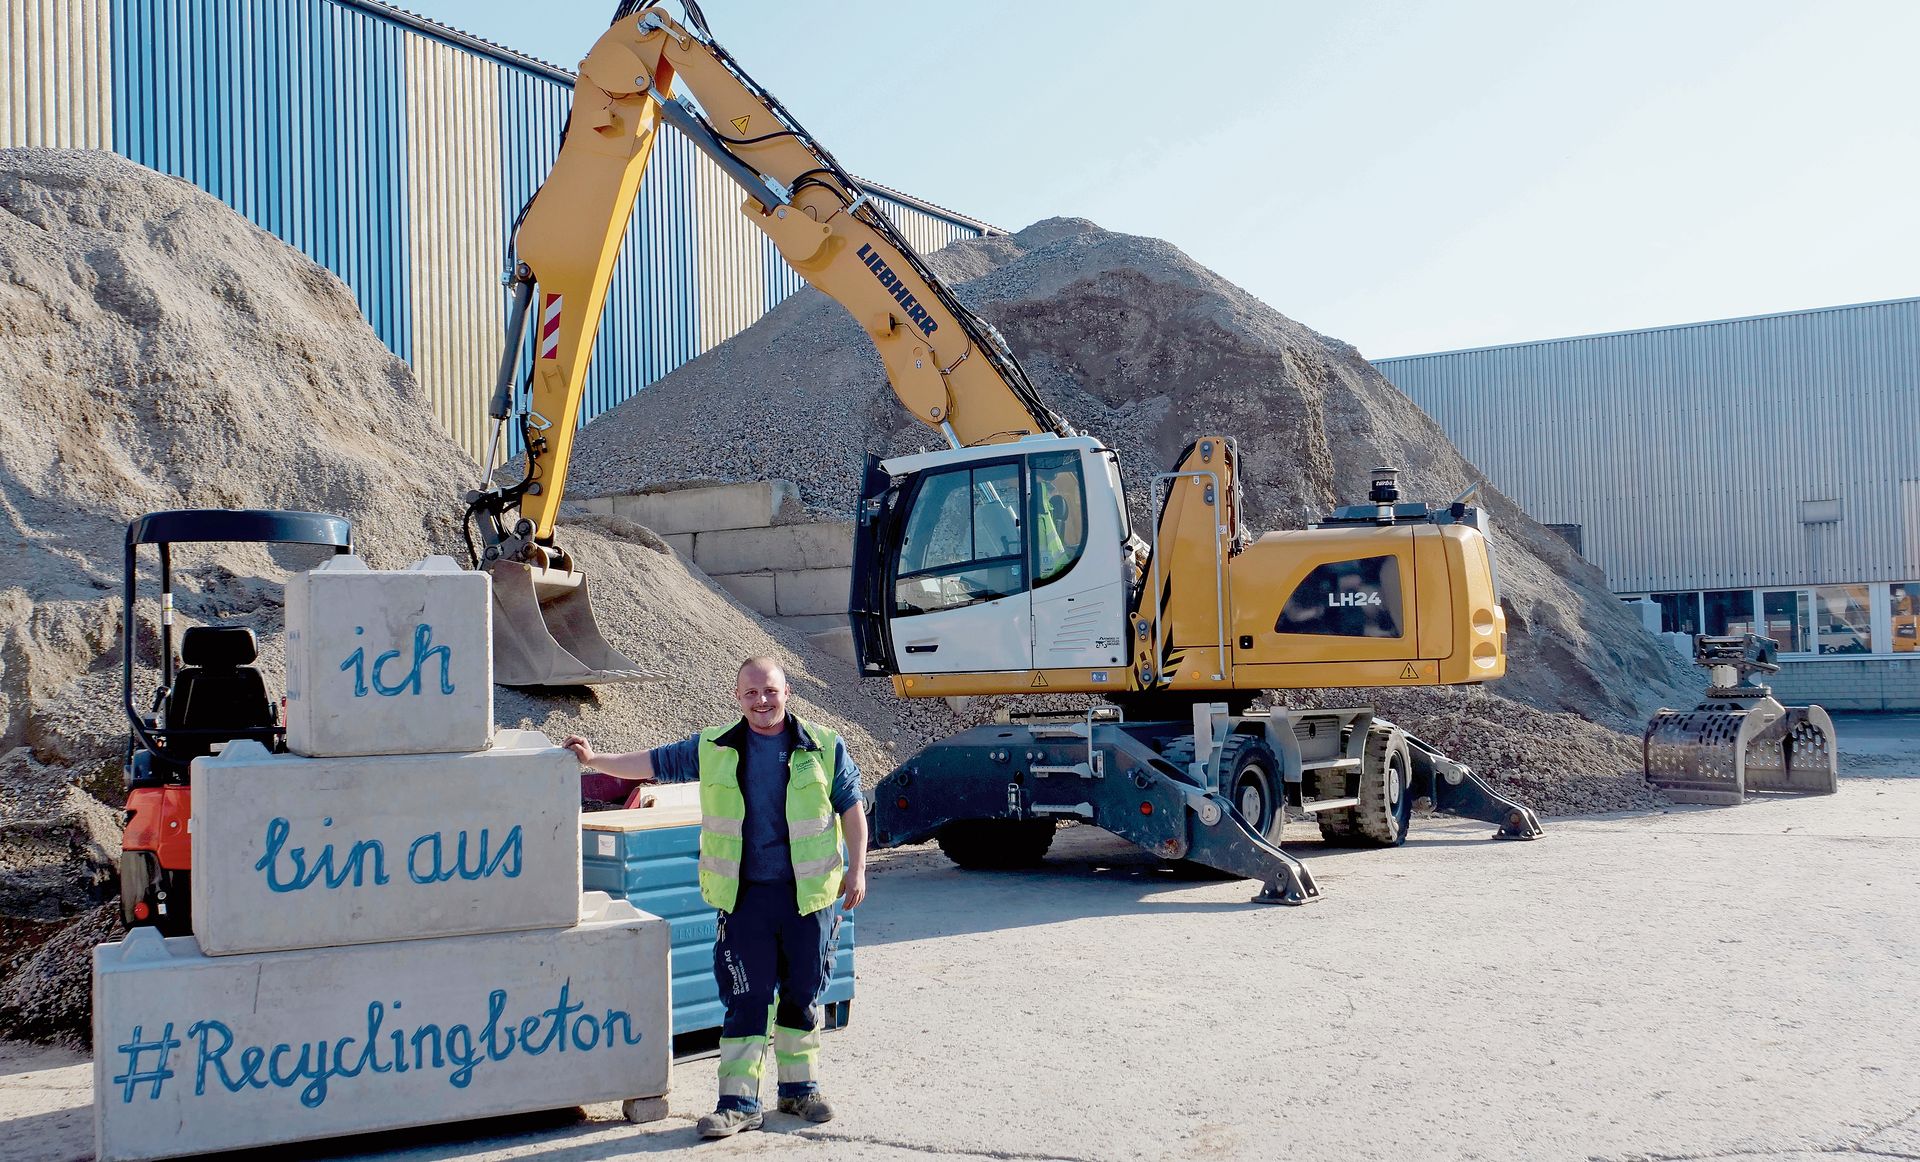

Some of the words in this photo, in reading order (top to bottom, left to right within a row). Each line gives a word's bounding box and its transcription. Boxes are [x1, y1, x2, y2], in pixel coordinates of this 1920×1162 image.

[856, 242, 939, 338] LIEBHERR
[1328, 592, 1382, 607] LH24
[340, 623, 455, 698] ich
[255, 816, 390, 893] bin
[408, 824, 523, 885] aus
[724, 949, 732, 962] AG
[727, 964, 740, 995] SCHMID
[113, 980, 643, 1108] #Recyclingbeton
